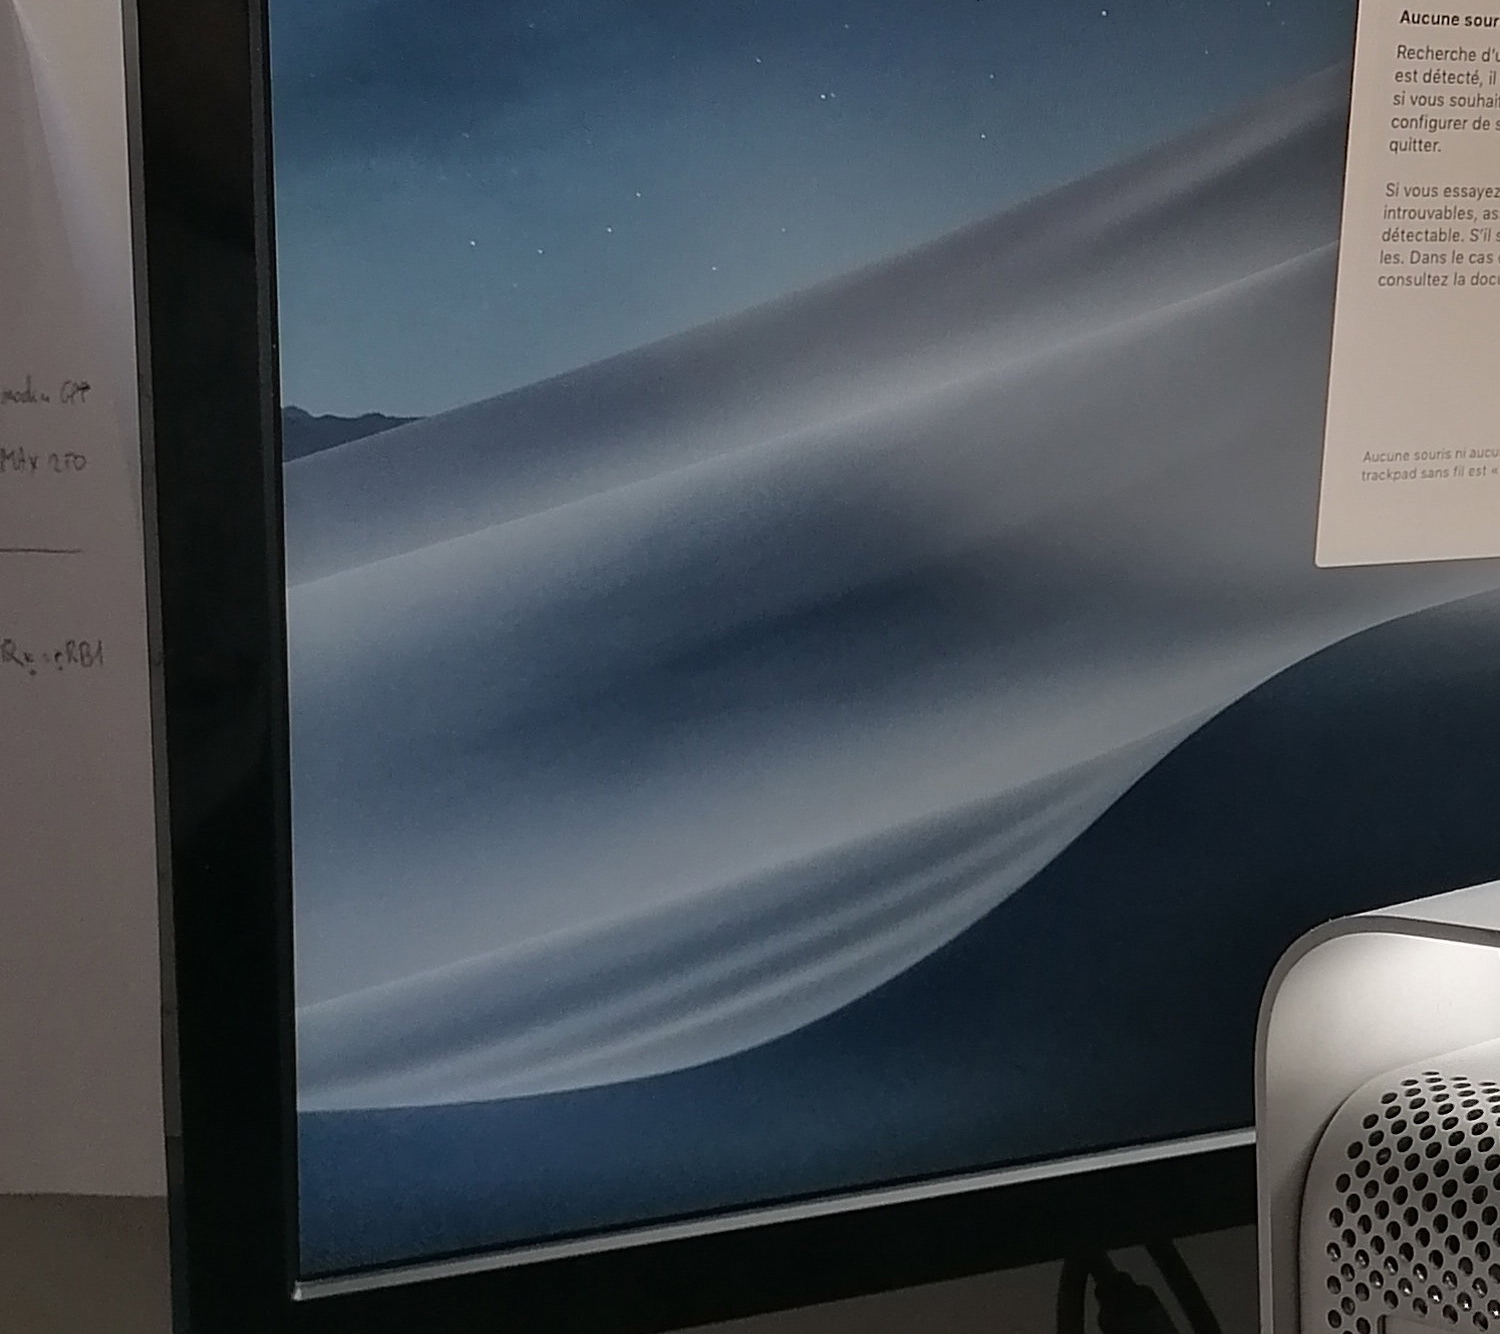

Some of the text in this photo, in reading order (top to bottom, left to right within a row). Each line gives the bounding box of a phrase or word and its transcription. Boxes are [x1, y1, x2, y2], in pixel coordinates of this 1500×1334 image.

[1399, 9, 1460, 27] Aucune
[1396, 43, 1477, 62] Recherche
[1394, 69, 1418, 84] est
[1422, 68, 1483, 88] détecté,
[1488, 70, 1497, 86] il
[1392, 90, 1406, 106] si
[1409, 94, 1445, 107] vous
[1390, 114, 1469, 133] configurer
[1471, 115, 1491, 131] de
[1388, 136, 1442, 155] quitter.
[1385, 181, 1400, 198] Si
[1403, 186, 1439, 198] vous
[1383, 204, 1478, 224] introuvables,
[1381, 226, 1465, 243] détectable.
[1379, 249, 1405, 265] les.
[1409, 249, 1447, 265] Dans
[1451, 249, 1465, 265] le
[1468, 253, 1494, 265] cas
[1377, 271, 1449, 287] consultez
[1453, 271, 1466, 287] la
[1362, 450, 1410, 463] Aucune
[1413, 447, 1452, 462] souris
[1454, 447, 1467, 460] ni
[1361, 467, 1418, 483] trackpad
[1420, 468, 1450, 479] sans
[1453, 465, 1465, 478] fil
[1467, 464, 1487, 478] est
